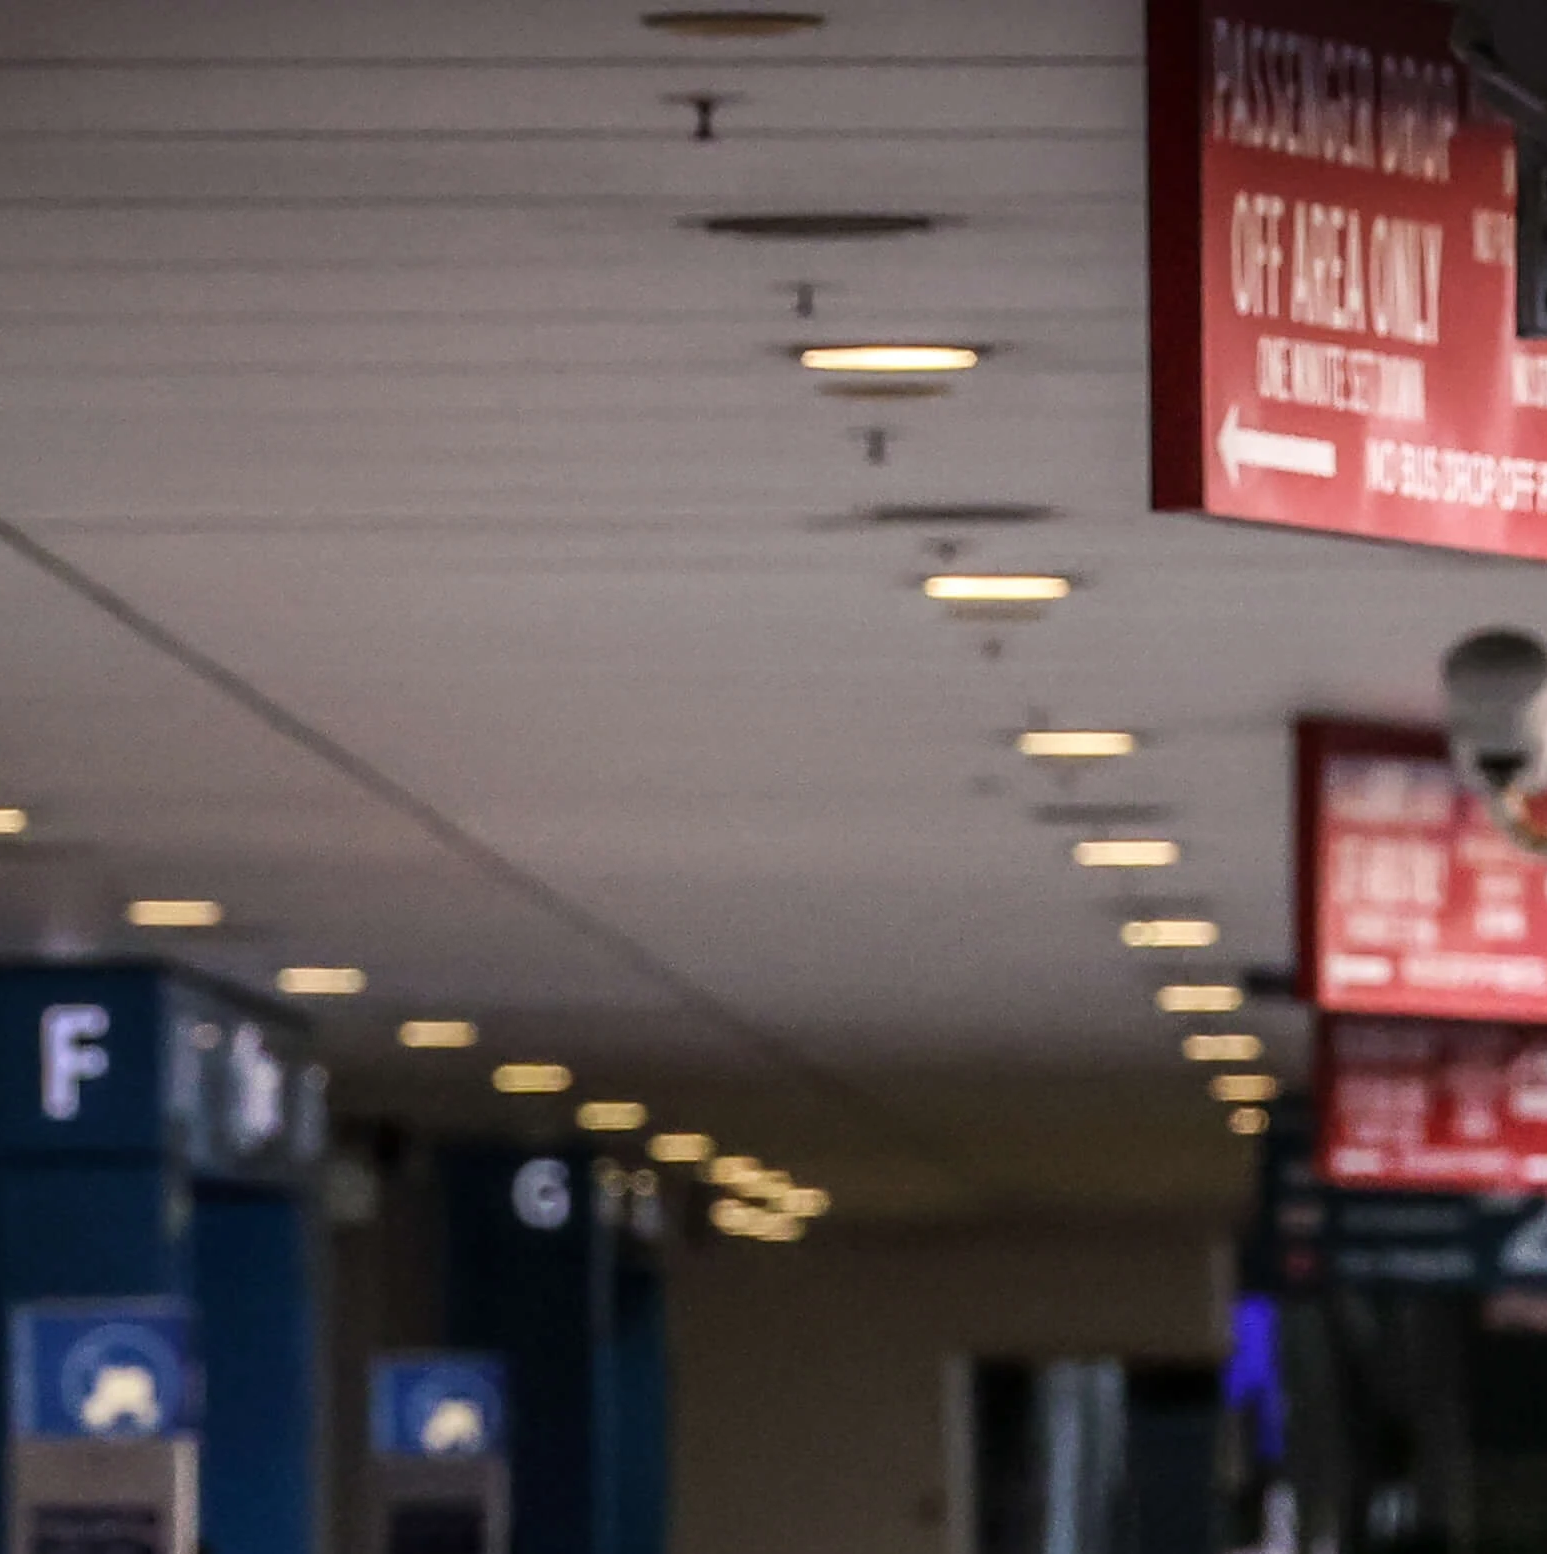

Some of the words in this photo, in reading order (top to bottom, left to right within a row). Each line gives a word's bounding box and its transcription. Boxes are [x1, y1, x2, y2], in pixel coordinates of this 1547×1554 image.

[1213, 15, 1375, 170] PASSENGER
[1381, 54, 1458, 184] DROP
[1231, 192, 1285, 317] OFF
[1291, 201, 1366, 333] AREA
[1370, 215, 1443, 345] ONLY
[1365, 438, 1396, 493] NO
[1399, 442, 1438, 502] BUS
[1442, 448, 1495, 508] DROP
[1497, 455, 1535, 512] OFF
[39, 1003, 110, 1120] F
[511, 1156, 572, 1230] G
